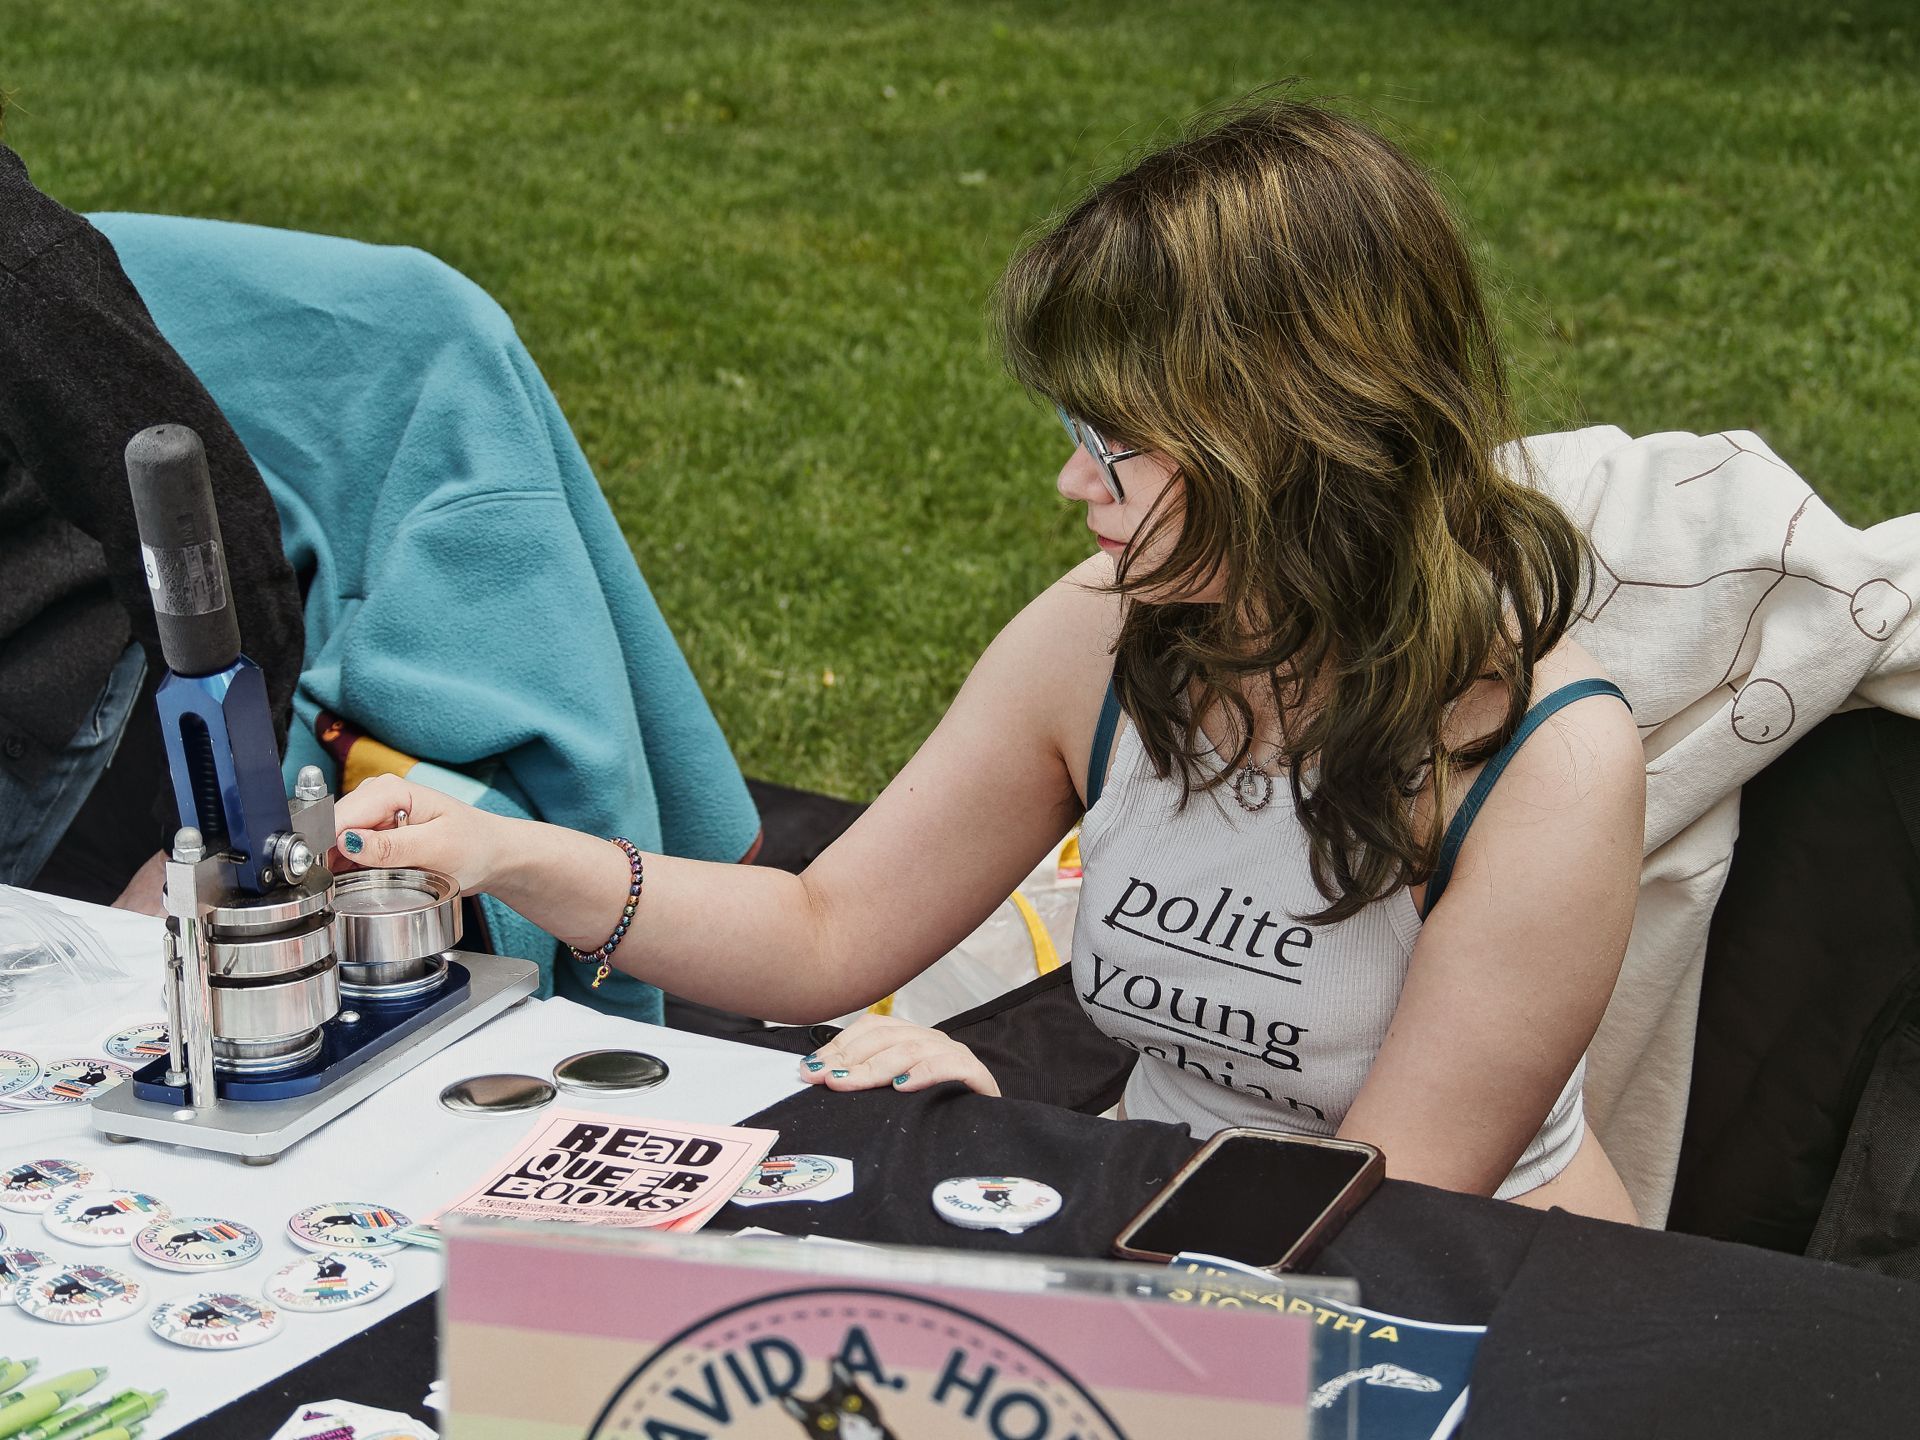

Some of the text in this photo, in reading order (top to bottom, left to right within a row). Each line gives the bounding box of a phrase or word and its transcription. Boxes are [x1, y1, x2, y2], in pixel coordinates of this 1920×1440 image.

[1102, 876, 1313, 968] polite
[1082, 953, 1309, 1073] young
[51, 1061, 96, 1071] DAVID
[115, 1069, 132, 1081] HO
[514, 1150, 710, 1194] QUEER
[787, 1175, 824, 1191] DAVID
[482, 1173, 690, 1213] BOOKS
[298, 1204, 331, 1221] HOWE
[943, 1195, 982, 1212] HOWE
[144, 1224, 169, 1244] HOWE
[308, 1228, 354, 1243] DAVID
[165, 1249, 216, 1260] DAVID
[348, 1252, 388, 1268] HOWE
[1368, 1326, 1399, 1343] A
[642, 1334, 804, 1440] AVID
[931, 1347, 1081, 1440] HO
